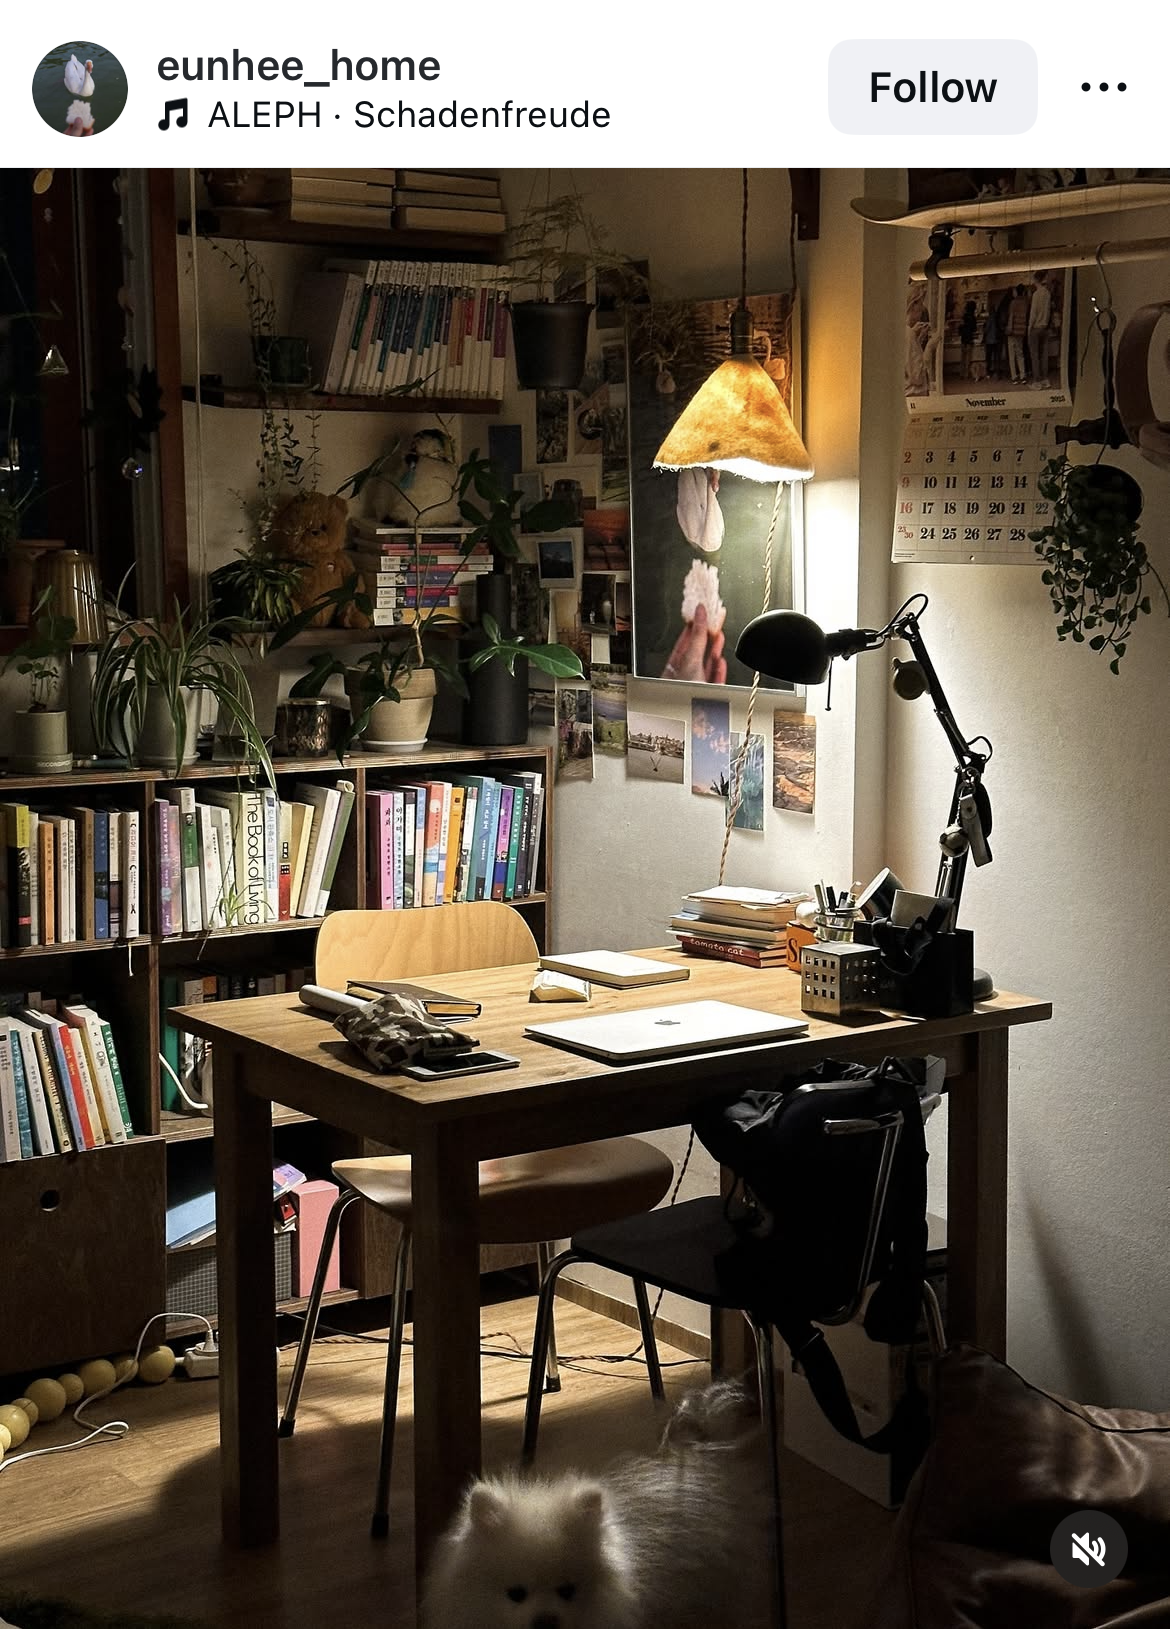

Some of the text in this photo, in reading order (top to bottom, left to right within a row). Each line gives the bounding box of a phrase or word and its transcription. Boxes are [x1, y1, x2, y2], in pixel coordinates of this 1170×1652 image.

[966, 398, 1006, 407] November
[1042, 423, 1048, 434] 1
[904, 452, 911, 462] 2
[926, 452, 933, 463] 3
[948, 451, 955, 462] 4
[970, 451, 978, 462] 5
[993, 451, 1001, 462] 6
[1016, 450, 1023, 461] 7
[902, 476, 1028, 488] 9 10 11 12 13 14
[900, 502, 1048, 514] 16 17 18 19 20 21 22
[920, 528, 935, 539] 24
[942, 528, 957, 539] 25
[964, 528, 979, 540] 26
[987, 528, 1002, 540] 27
[1010, 529, 1025, 541] 28
[244, 793, 264, 924] The Book of Living
[690, 938, 745, 957] tomato cat
